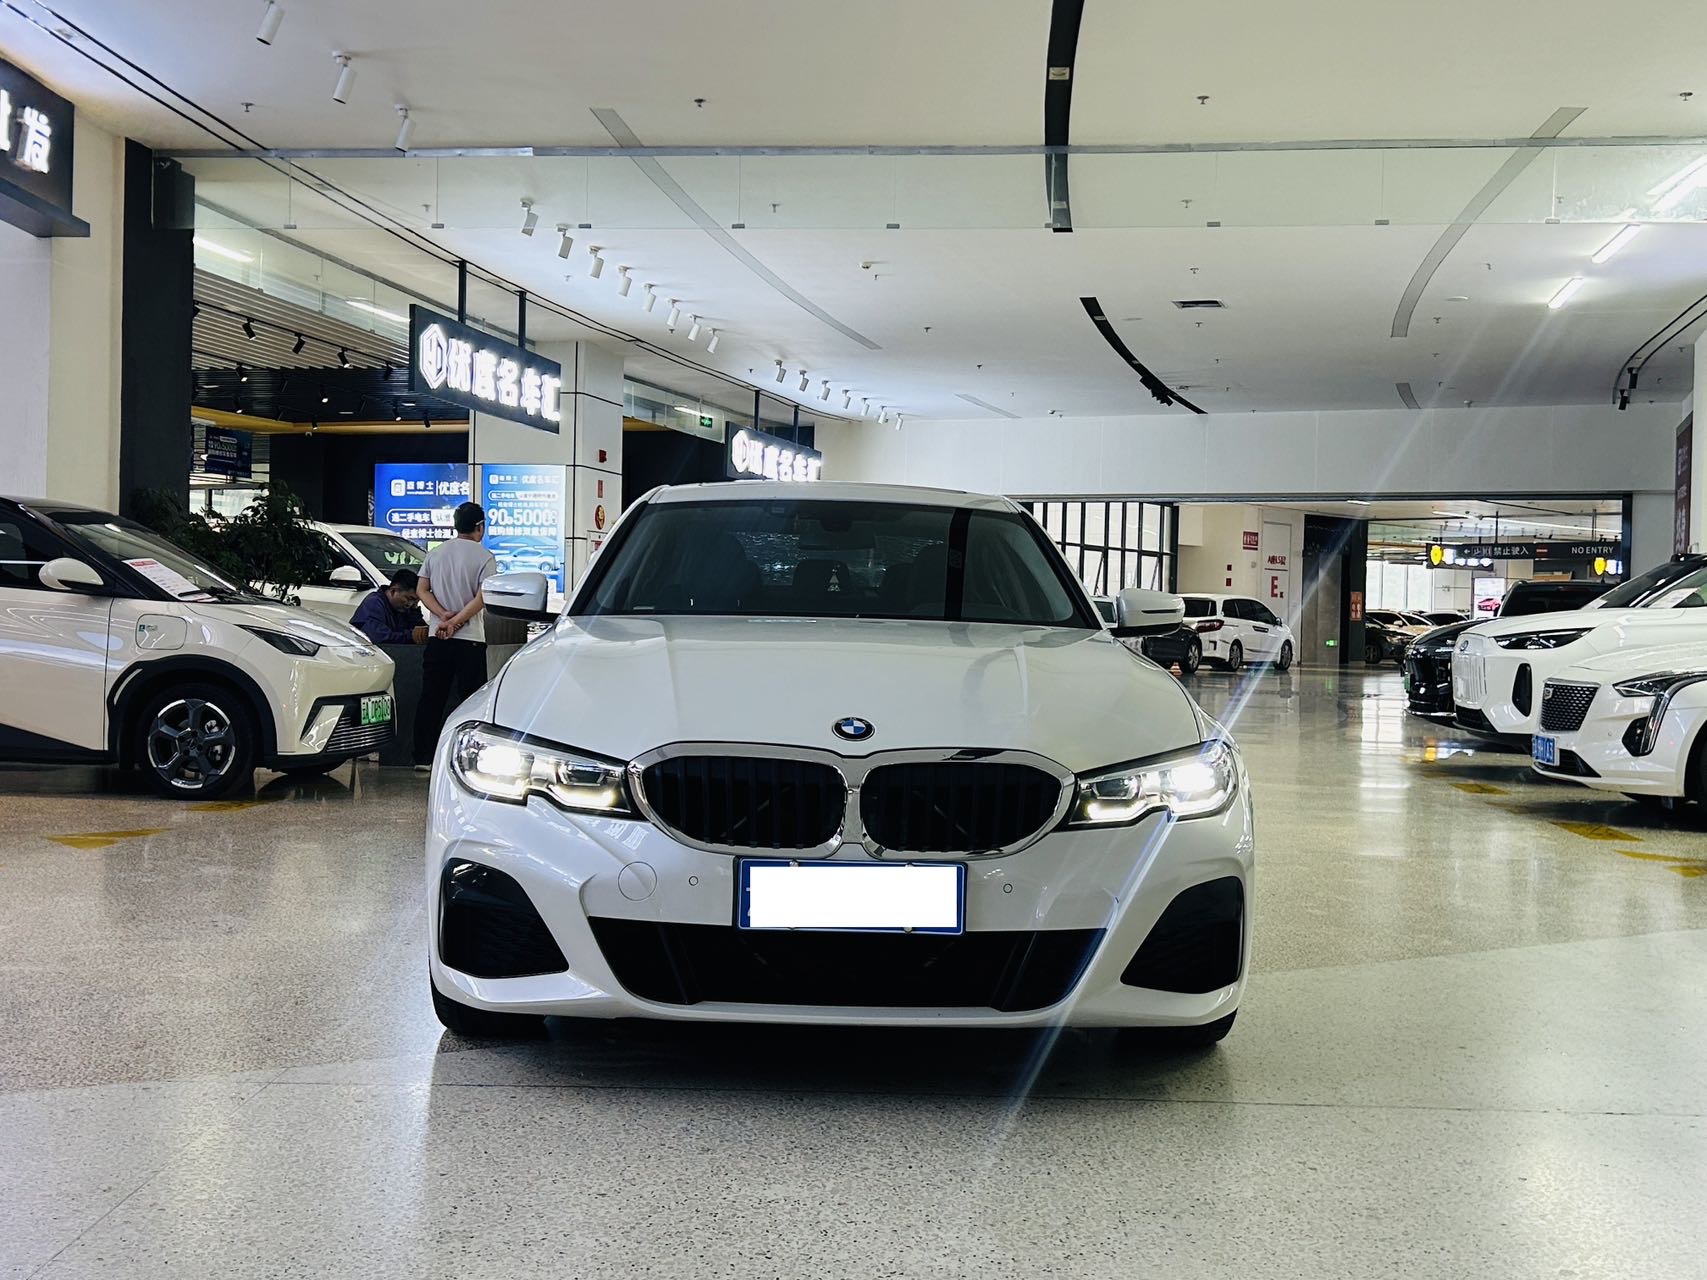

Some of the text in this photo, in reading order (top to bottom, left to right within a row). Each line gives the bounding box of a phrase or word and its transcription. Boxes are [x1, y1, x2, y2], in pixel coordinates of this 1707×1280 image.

[1493, 546, 1529, 556] 禁止驶入
[1571, 546, 1614, 554] NO ENTRY
